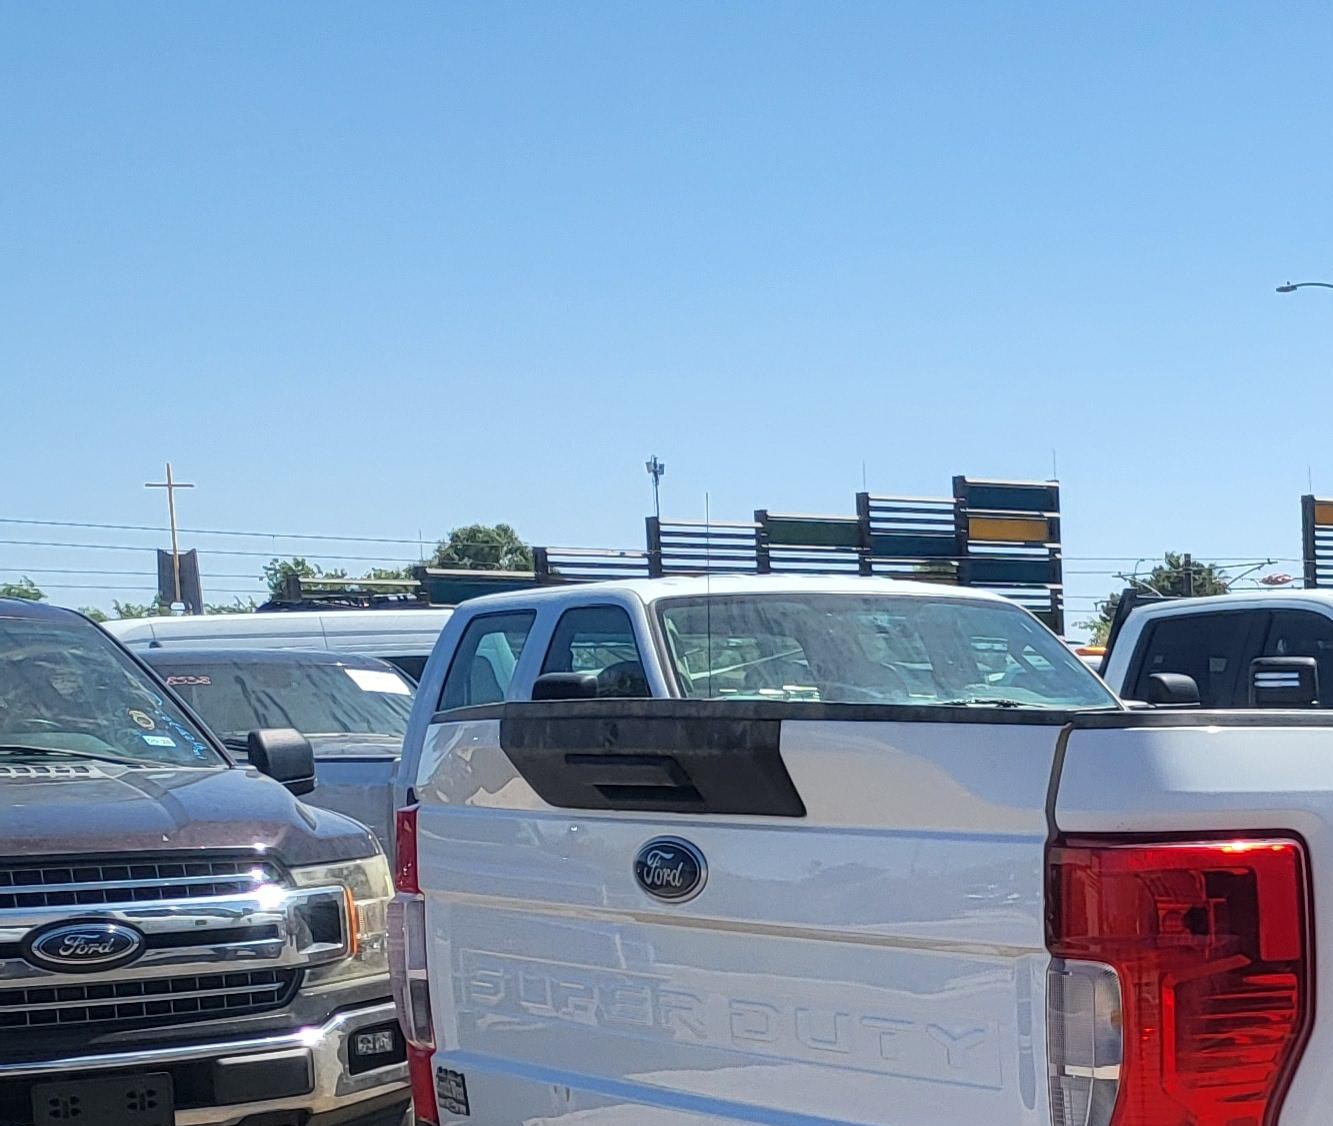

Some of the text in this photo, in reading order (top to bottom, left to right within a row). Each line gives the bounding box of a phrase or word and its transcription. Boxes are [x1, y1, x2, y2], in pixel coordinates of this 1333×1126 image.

[643, 849, 684, 887] Ford
[58, 934, 115, 956] Ford
[470, 967, 986, 1069] SUPER DUTY
